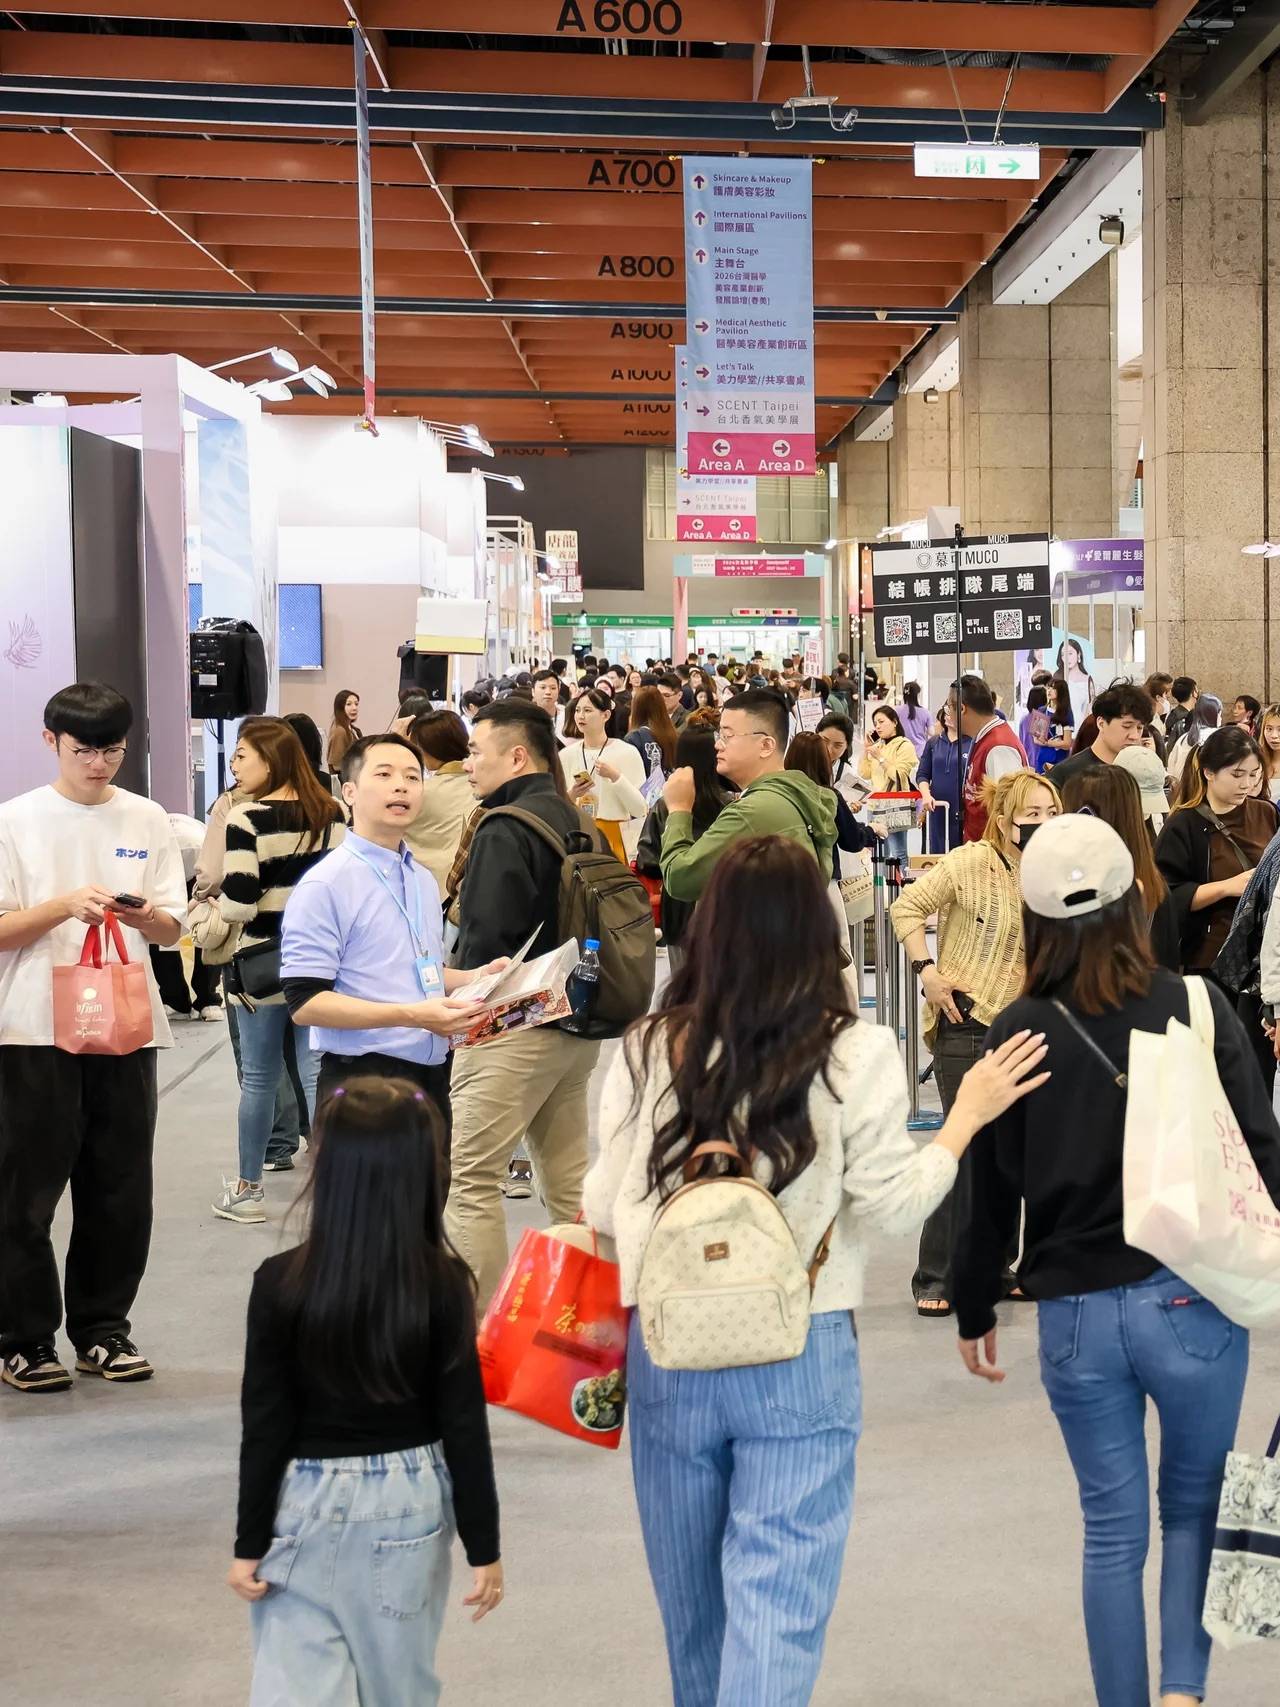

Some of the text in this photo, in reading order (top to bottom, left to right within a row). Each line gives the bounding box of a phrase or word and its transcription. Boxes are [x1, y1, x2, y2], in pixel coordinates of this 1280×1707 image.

[713, 174, 792, 185] Skincare & Makeup
[713, 186, 775, 198] 護膚美容彩妝
[714, 211, 808, 220] International Pavilions
[714, 222, 755, 233] 國際展區
[714, 246, 759, 257] Main Stage
[715, 258, 746, 269] 主舞台
[715, 318, 787, 328] Medical Aesthetic
[715, 327, 749, 335] Pavilion
[716, 338, 808, 350] 醫學美容產業創新區
[716, 363, 755, 371] Let's Talk
[717, 400, 800, 413] SCENT Taipei
[717, 414, 799, 425] 台北香氣美學展
[699, 458, 805, 472] Area A Area D
[683, 531, 750, 540] Area A Area D
[987, 534, 1009, 544] MUCO
[911, 539, 931, 549] MUCO
[965, 549, 999, 565] MUCO
[888, 573, 1035, 599] 結帳排隊尾端
[967, 626, 990, 635] LINE
